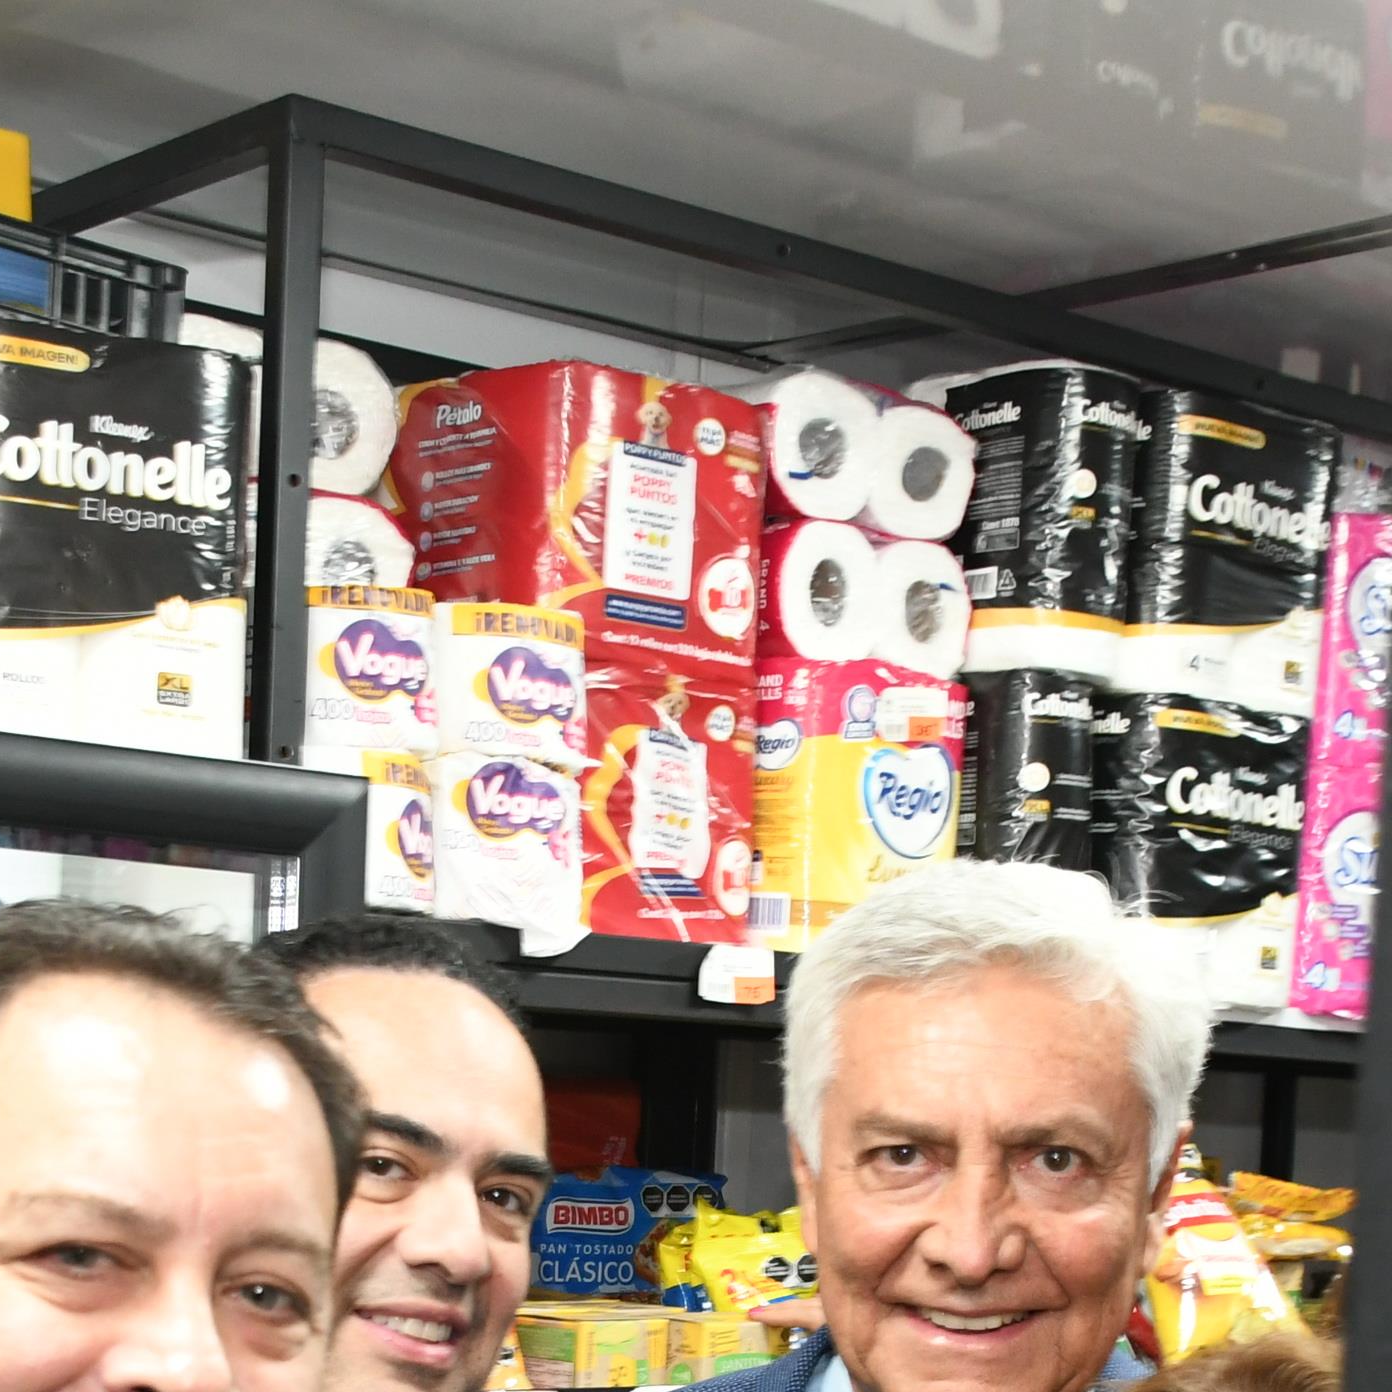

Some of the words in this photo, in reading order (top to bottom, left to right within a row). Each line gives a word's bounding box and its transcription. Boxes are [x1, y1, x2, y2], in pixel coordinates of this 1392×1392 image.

[436, 400, 482, 429] Pétalo
[956, 400, 1022, 432] Cottonelle
[79, 498, 208, 537] Elegance
[337, 632, 428, 686] Vogue
[489, 658, 577, 711] Vogue
[470, 774, 566, 824] Vogue
[876, 771, 945, 820] Regio
[553, 1204, 629, 1226] BIMBO
[539, 1243, 567, 1255] PAN
[575, 1243, 634, 1255] TOSTADO
[539, 1256, 634, 1284] CLÁSICO
